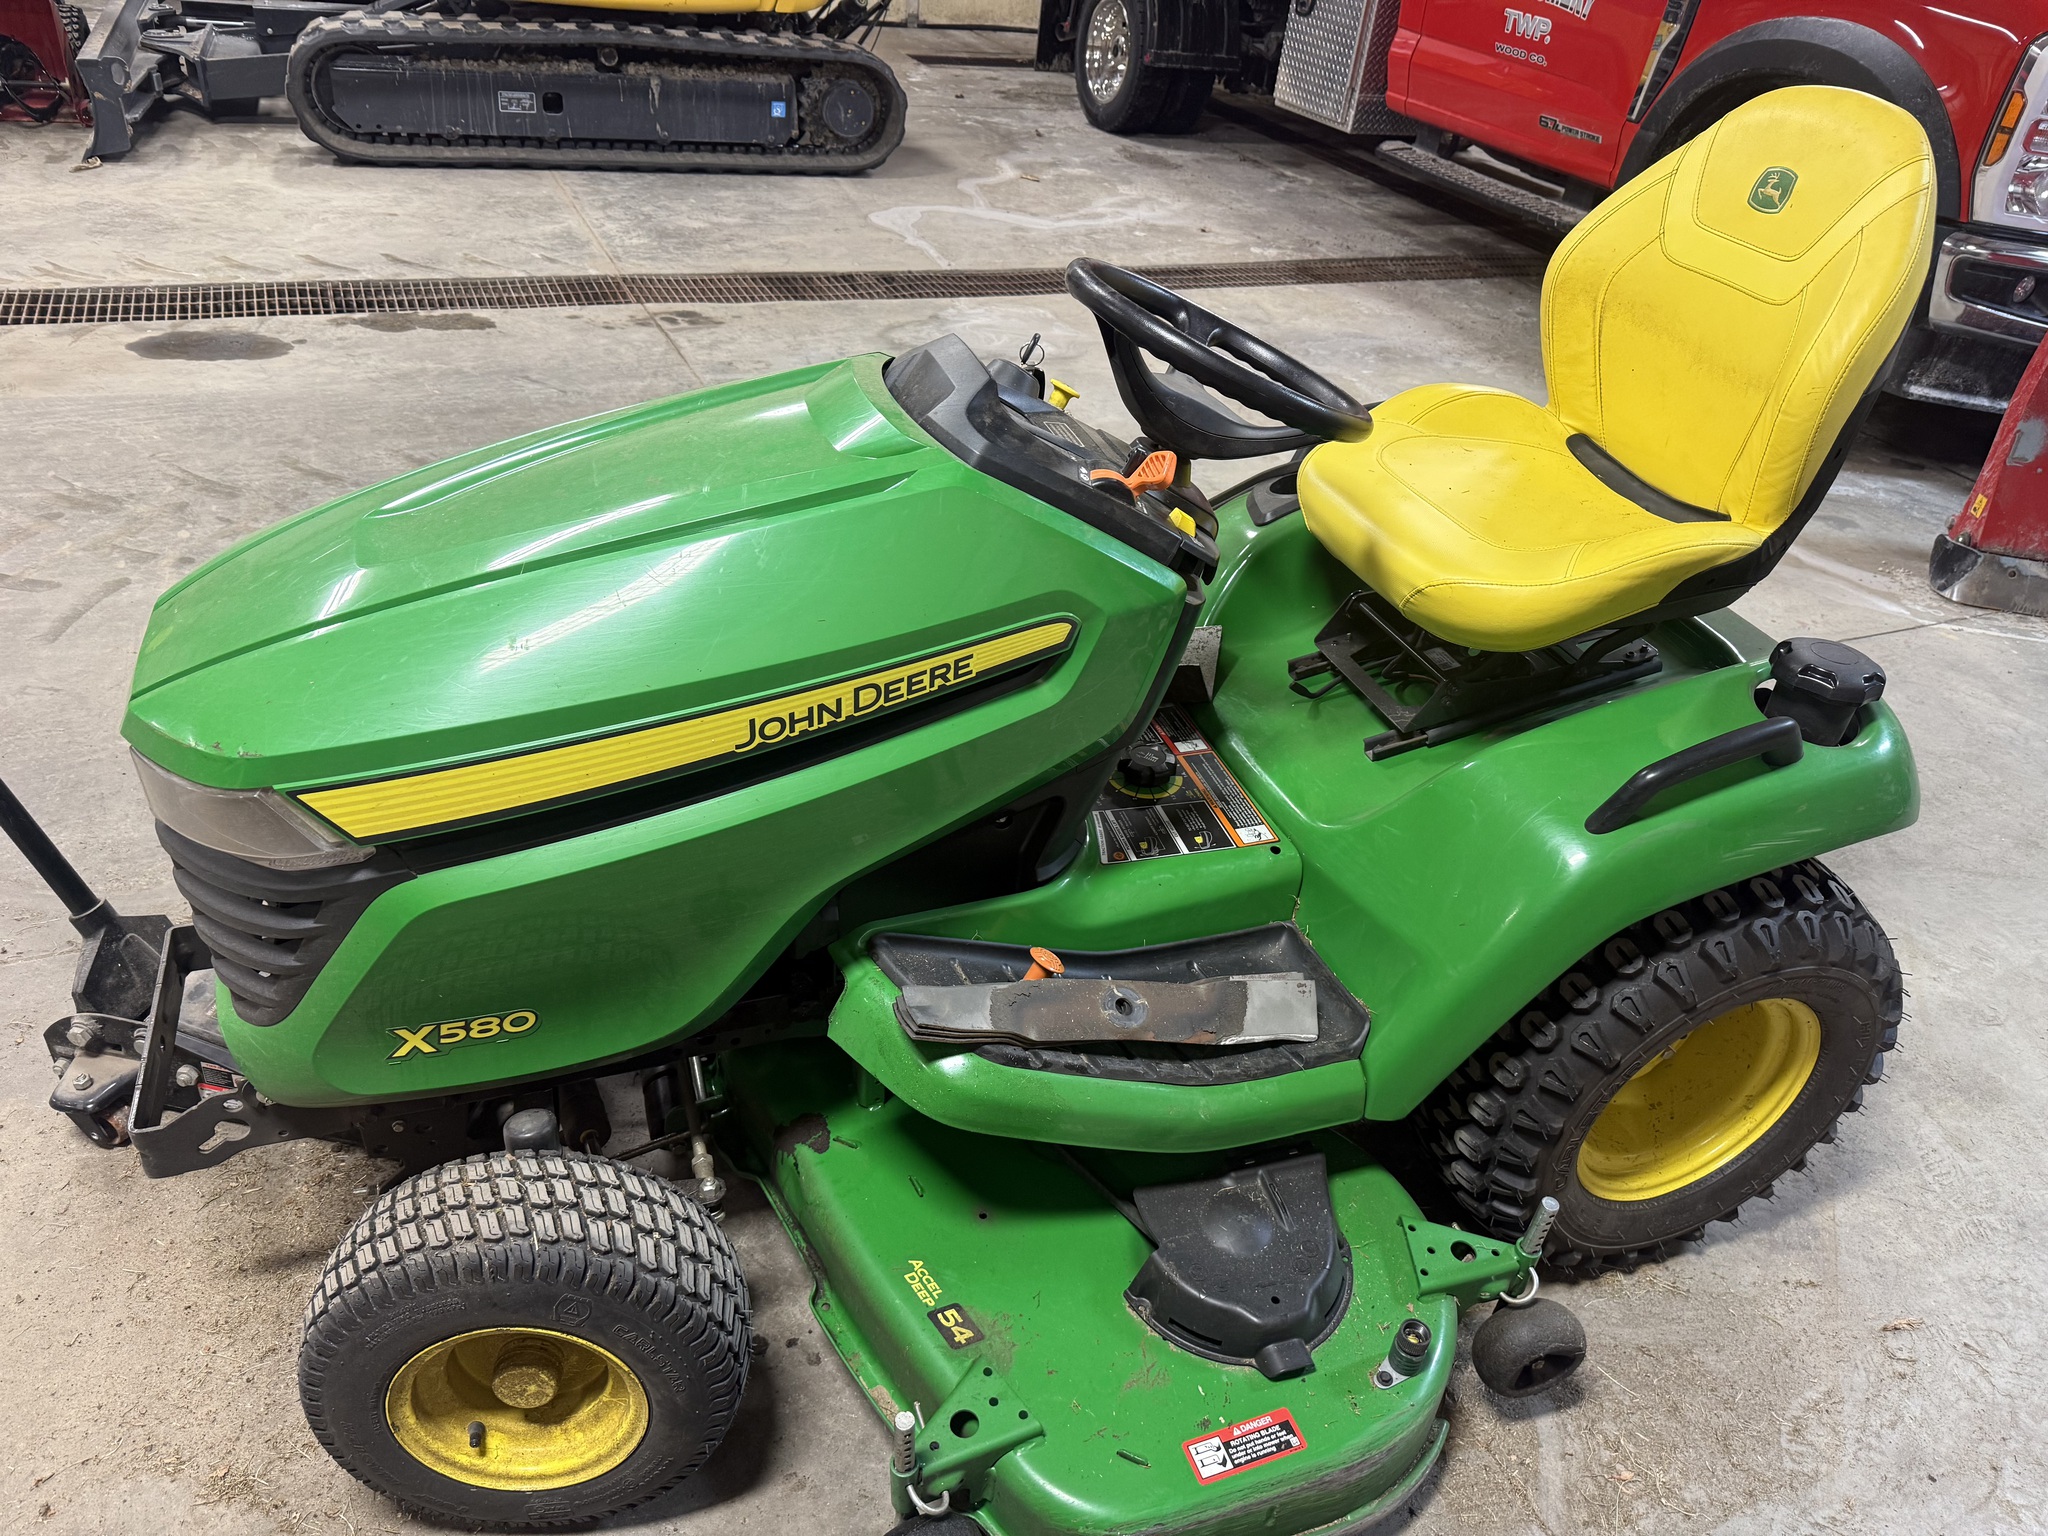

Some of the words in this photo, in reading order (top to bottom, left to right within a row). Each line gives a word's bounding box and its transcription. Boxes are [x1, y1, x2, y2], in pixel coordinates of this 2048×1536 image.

[1504, 8, 1552, 44] TWP.
[1495, 42, 1527, 59] WOOD
[1529, 52, 1547, 66] CO.
[1561, 123, 1579, 138] POWER
[1580, 130, 1602, 144] STROKE
[734, 696, 844, 750] JOHN
[853, 654, 976, 715] DEERE
[391, 1011, 537, 1058] X580
[904, 1272, 936, 1307] DEEP
[908, 1260, 942, 1299] ACCEL
[937, 1309, 974, 1344] 54
[612, 1324, 685, 1393] CARLSTAR
[1230, 1432, 1260, 1447] ROTATING
[1260, 1425, 1281, 1436] BLADE
[1240, 1416, 1272, 1433] DANGER
[1231, 1450, 1246, 1459] under
[1263, 1439, 1280, 1448] mower
[1234, 1455, 1251, 1464] engine
[1257, 1446, 1277, 1457] running
[1246, 1441, 1255, 1449] put
[1254, 1436, 1270, 1445] hands
